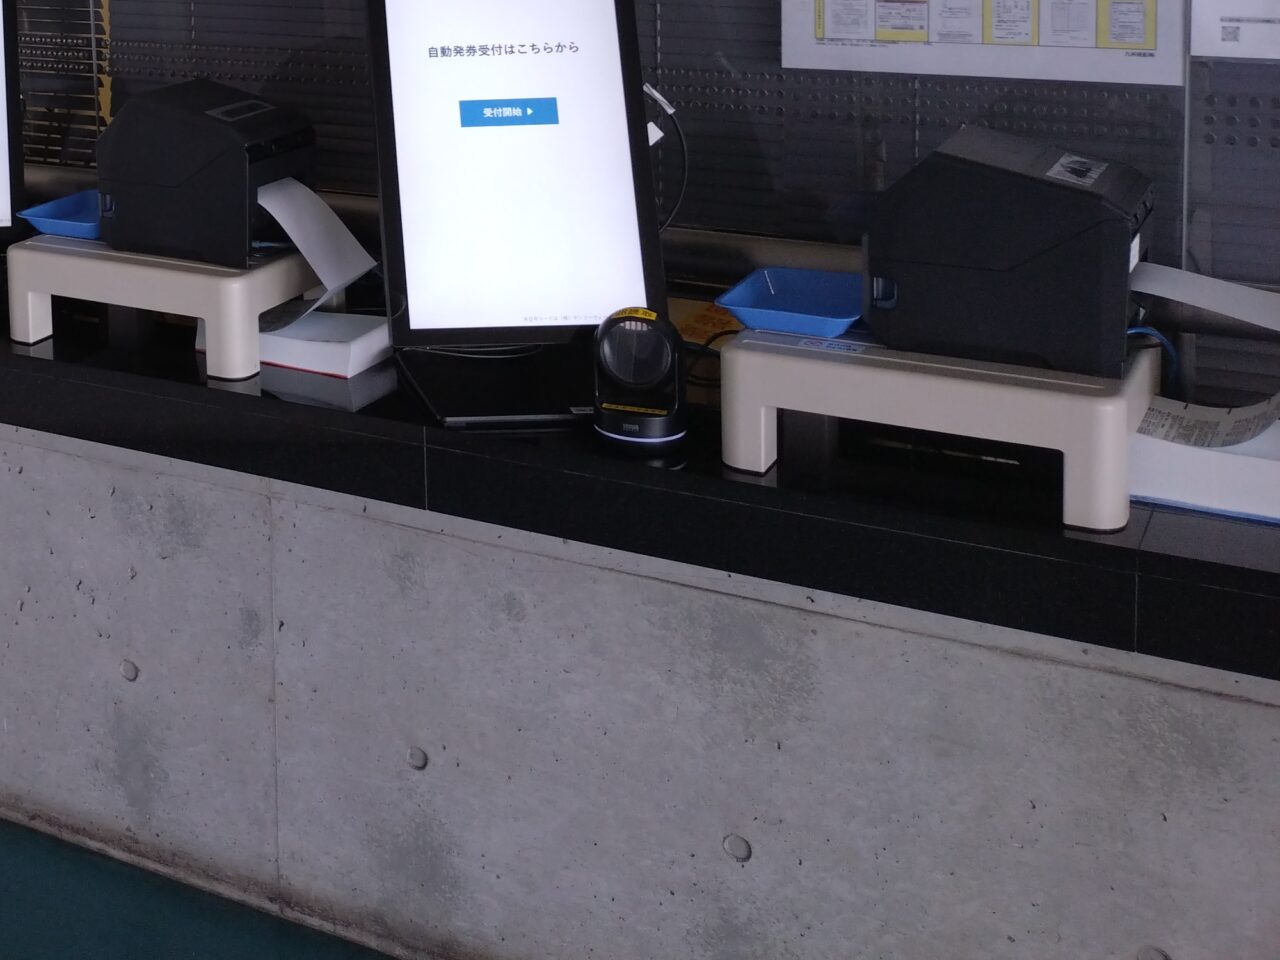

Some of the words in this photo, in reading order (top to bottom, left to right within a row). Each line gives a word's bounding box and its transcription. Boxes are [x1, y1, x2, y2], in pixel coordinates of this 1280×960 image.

[427, 42, 580, 58] 自動発券受付はこちらから
[482, 106, 523, 118] 受付開始
